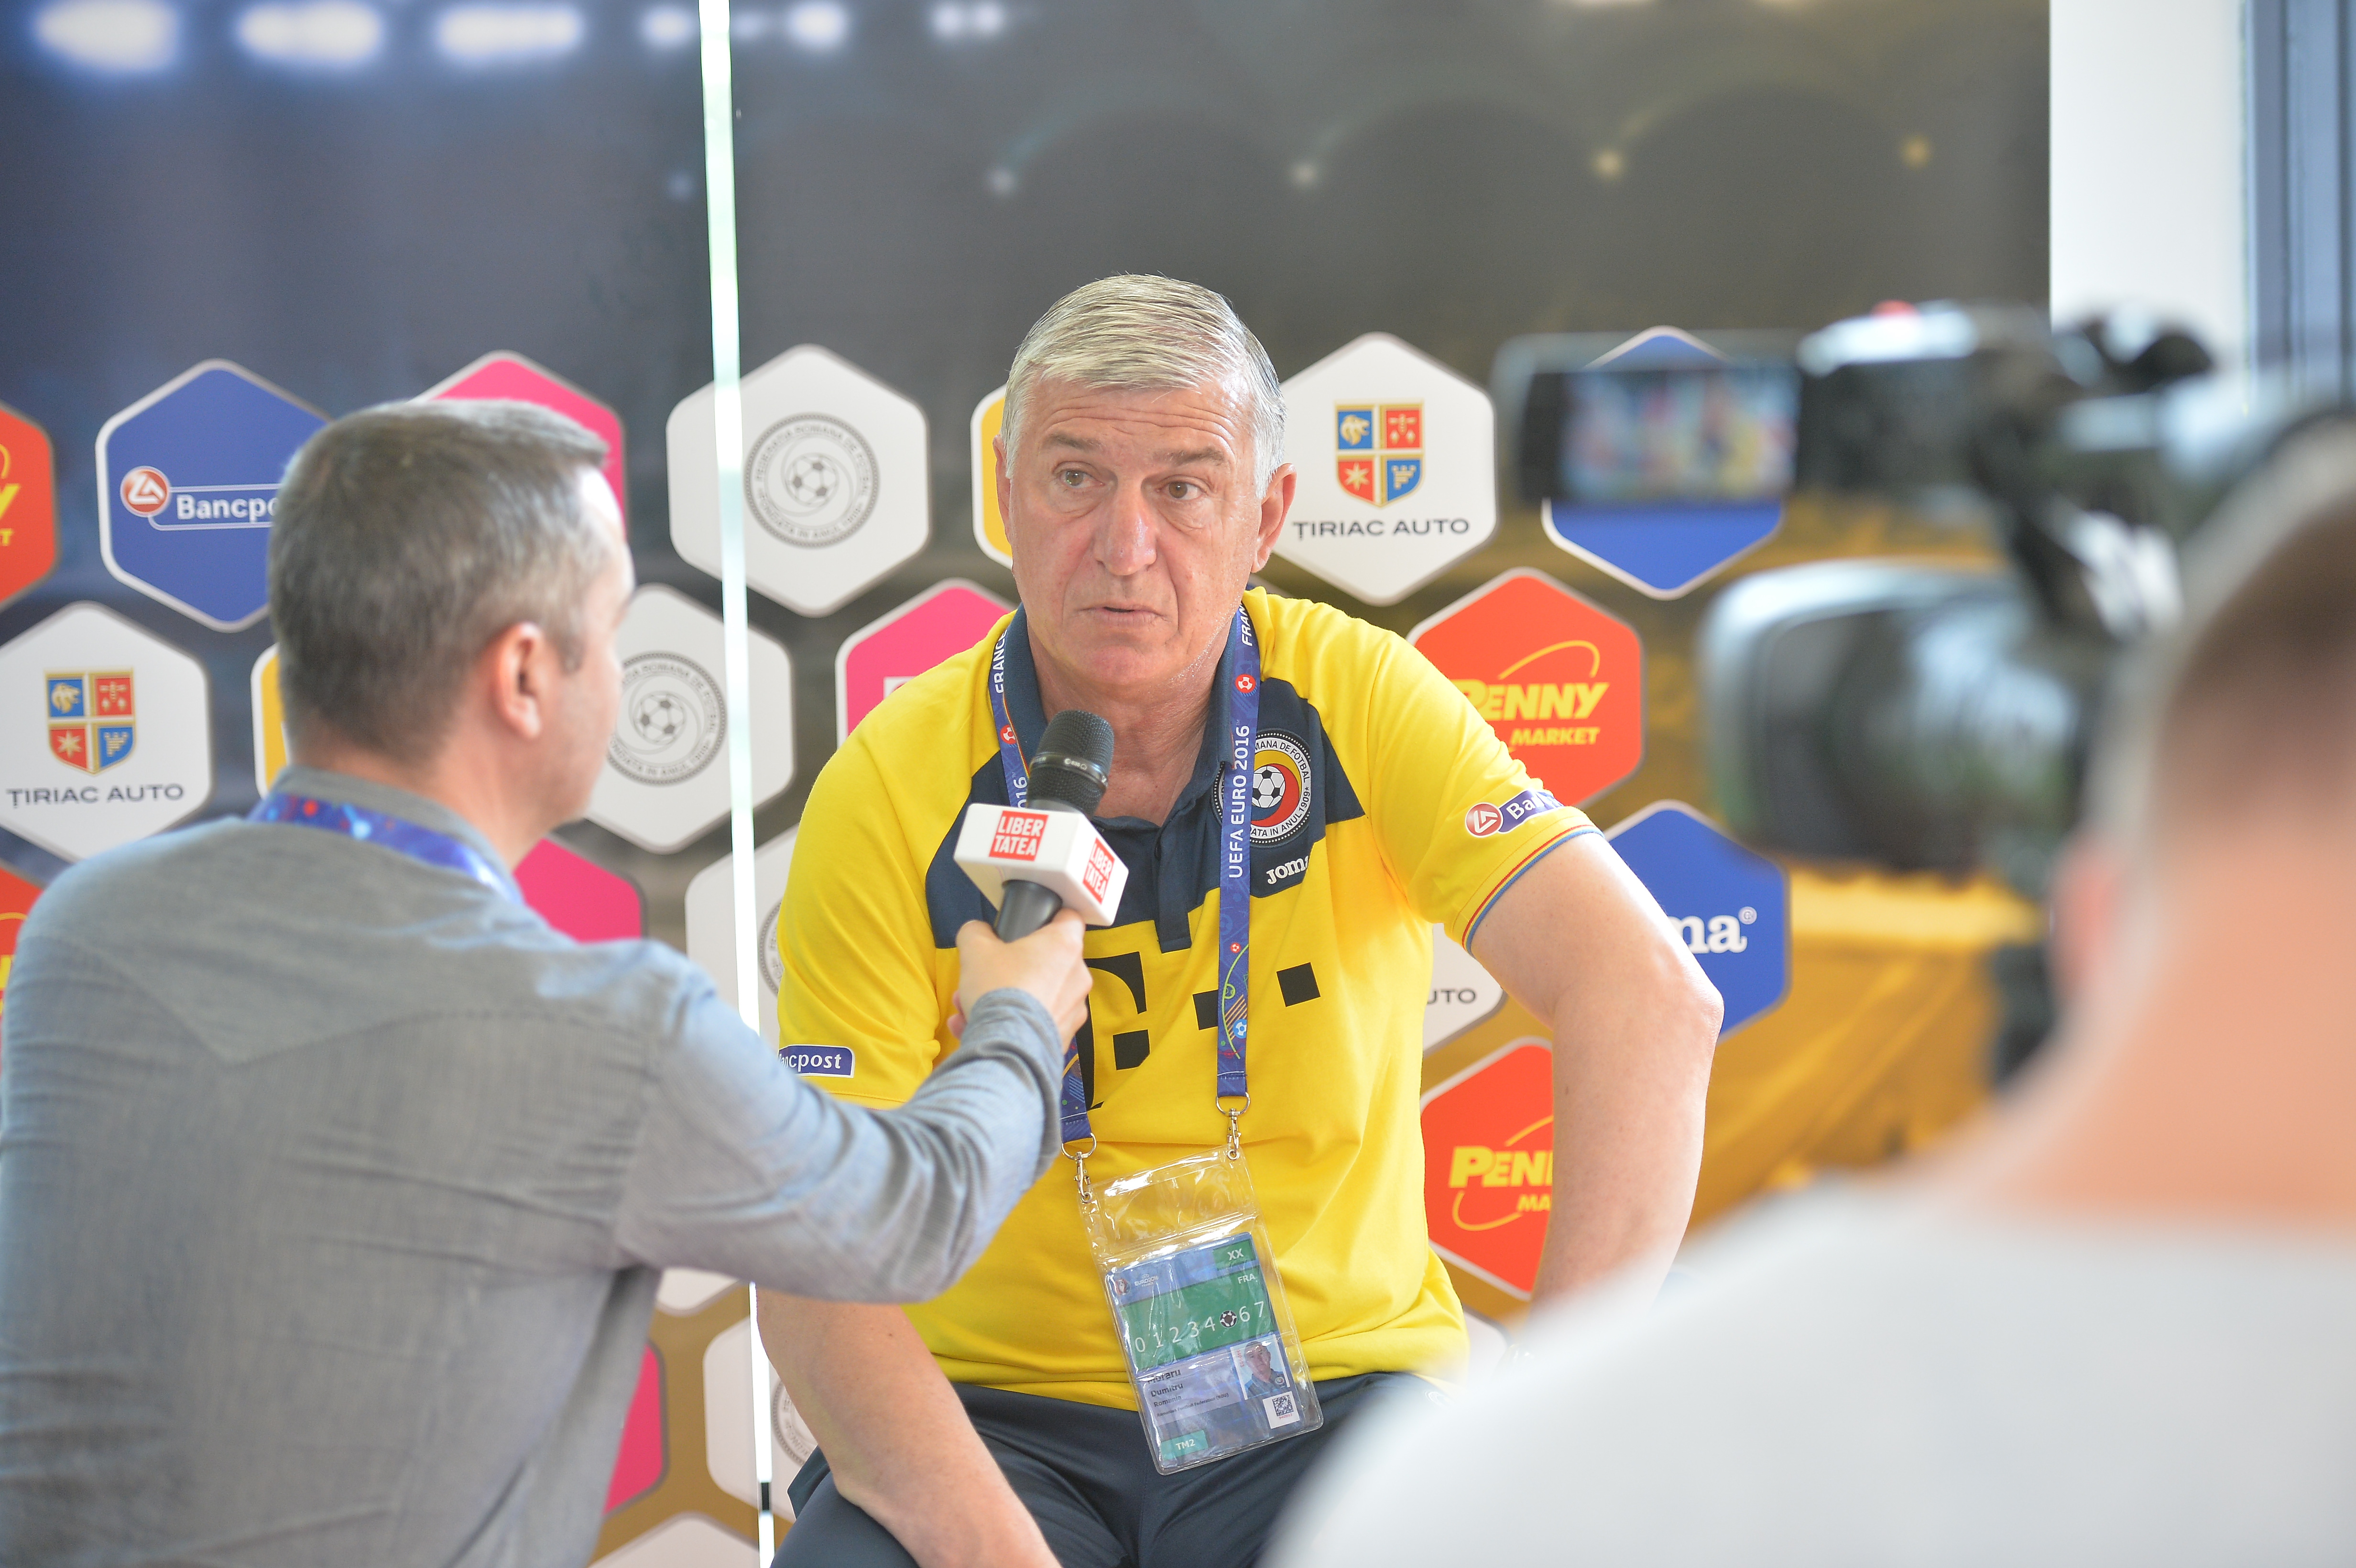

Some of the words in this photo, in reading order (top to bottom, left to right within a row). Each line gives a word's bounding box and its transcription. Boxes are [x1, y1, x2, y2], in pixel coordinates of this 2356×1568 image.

[176, 494, 279, 522] Bancpo
[1393, 518, 1470, 535] AUTO
[1239, 604, 1253, 646] FRAN
[1234, 725, 1250, 771] 2016
[1510, 726, 1601, 746] MARKET
[1279, 742, 1291, 752] DE
[1290, 748, 1310, 784] FOTBAL
[107, 783, 184, 804] AUTO
[1231, 775, 1247, 825] EURO
[997, 816, 1044, 837] LIBER
[1270, 827, 1279, 836] IN
[1281, 812, 1303, 833] ANUL
[993, 836, 1038, 856] TATEA
[1229, 828, 1244, 878] UEFA
[1090, 843, 1113, 880] LIBER
[1086, 863, 1107, 901] TATEA
[1448, 1145, 1553, 1188] PEN
[1227, 1248, 1244, 1261] XX
[1237, 1274, 1256, 1285] FRA
[1169, 1327, 1181, 1343] 2
[1188, 1321, 1200, 1338] 3
[1204, 1316, 1216, 1332] 4
[1239, 1306, 1251, 1322] 6
[1254, 1301, 1265, 1318] 7
[1175, 1438, 1196, 1451] TM2
